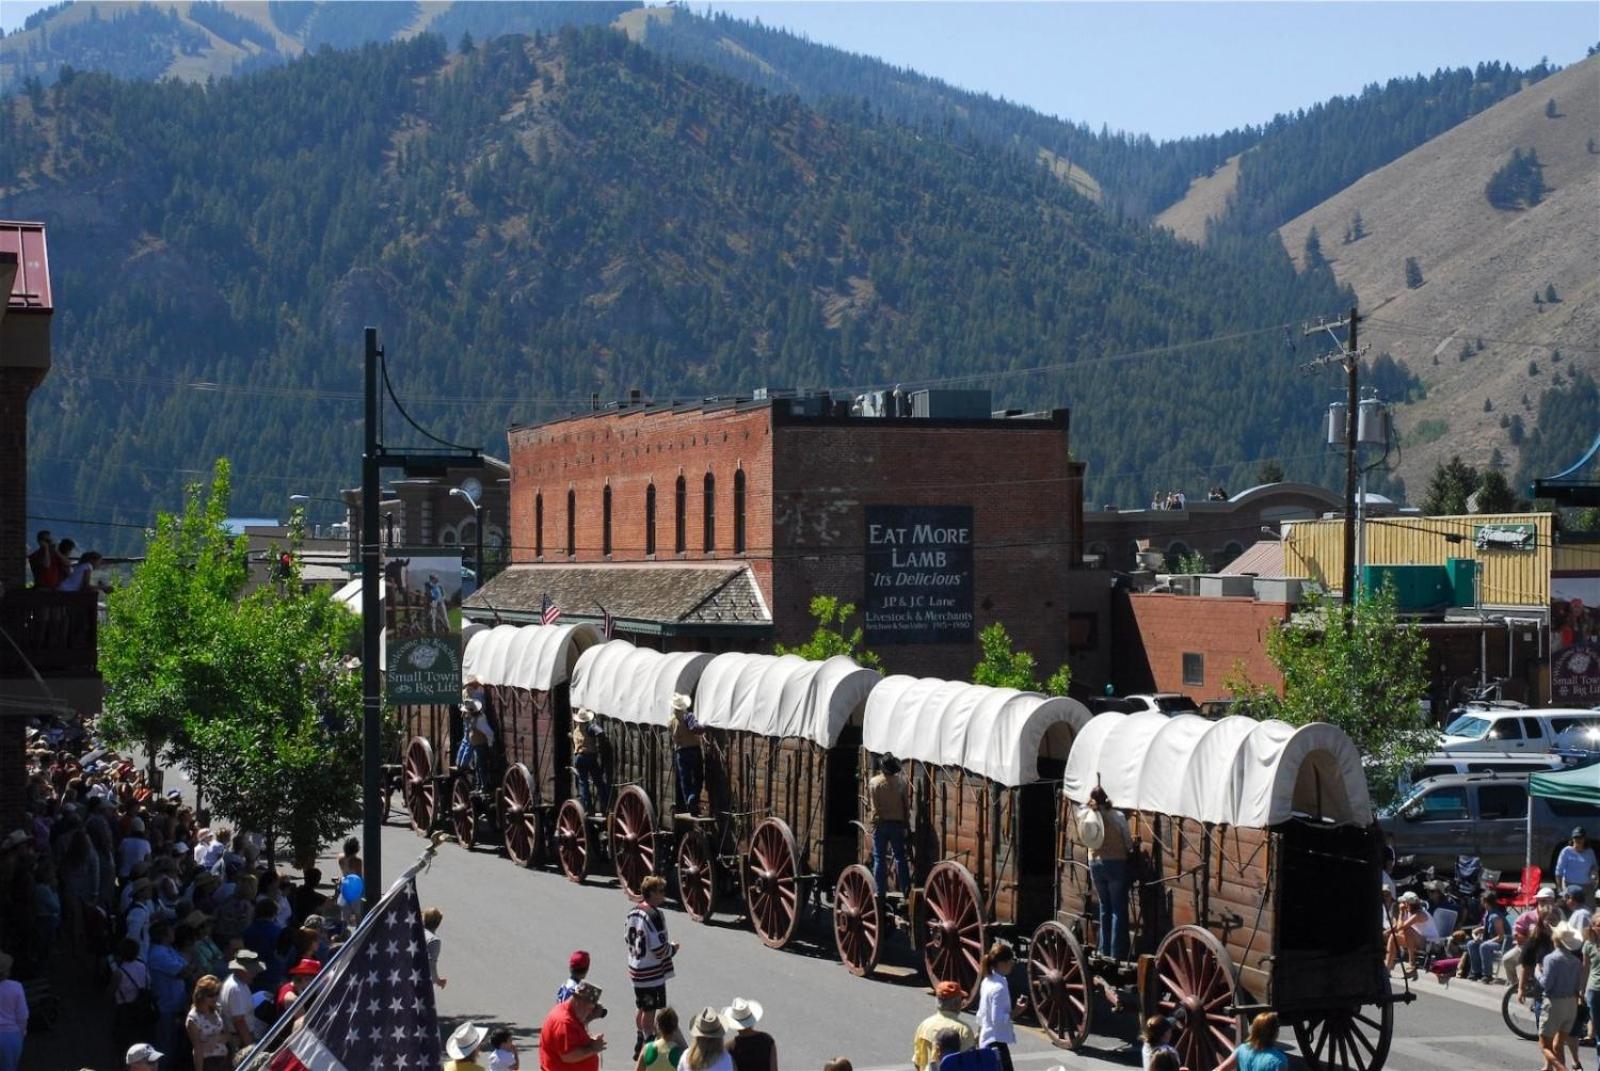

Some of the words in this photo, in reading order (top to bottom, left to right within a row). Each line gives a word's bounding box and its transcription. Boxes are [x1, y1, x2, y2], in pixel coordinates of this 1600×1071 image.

[869, 524, 907, 544] EAT
[912, 524, 969, 544] MORE
[892, 548, 946, 568] LAMB
[929, 596, 956, 607] Lane
[865, 610, 913, 621] Livestock
[915, 610, 923, 621] &
[924, 610, 973, 621] Merchants
[388, 639, 418, 672] Welcome
[389, 671, 422, 682] Small
[424, 671, 459, 682] Town
[1553, 675, 1577, 687] Small
[416, 682, 434, 696] Big
[437, 682, 459, 693] Life
[1573, 684, 1587, 697] Big
